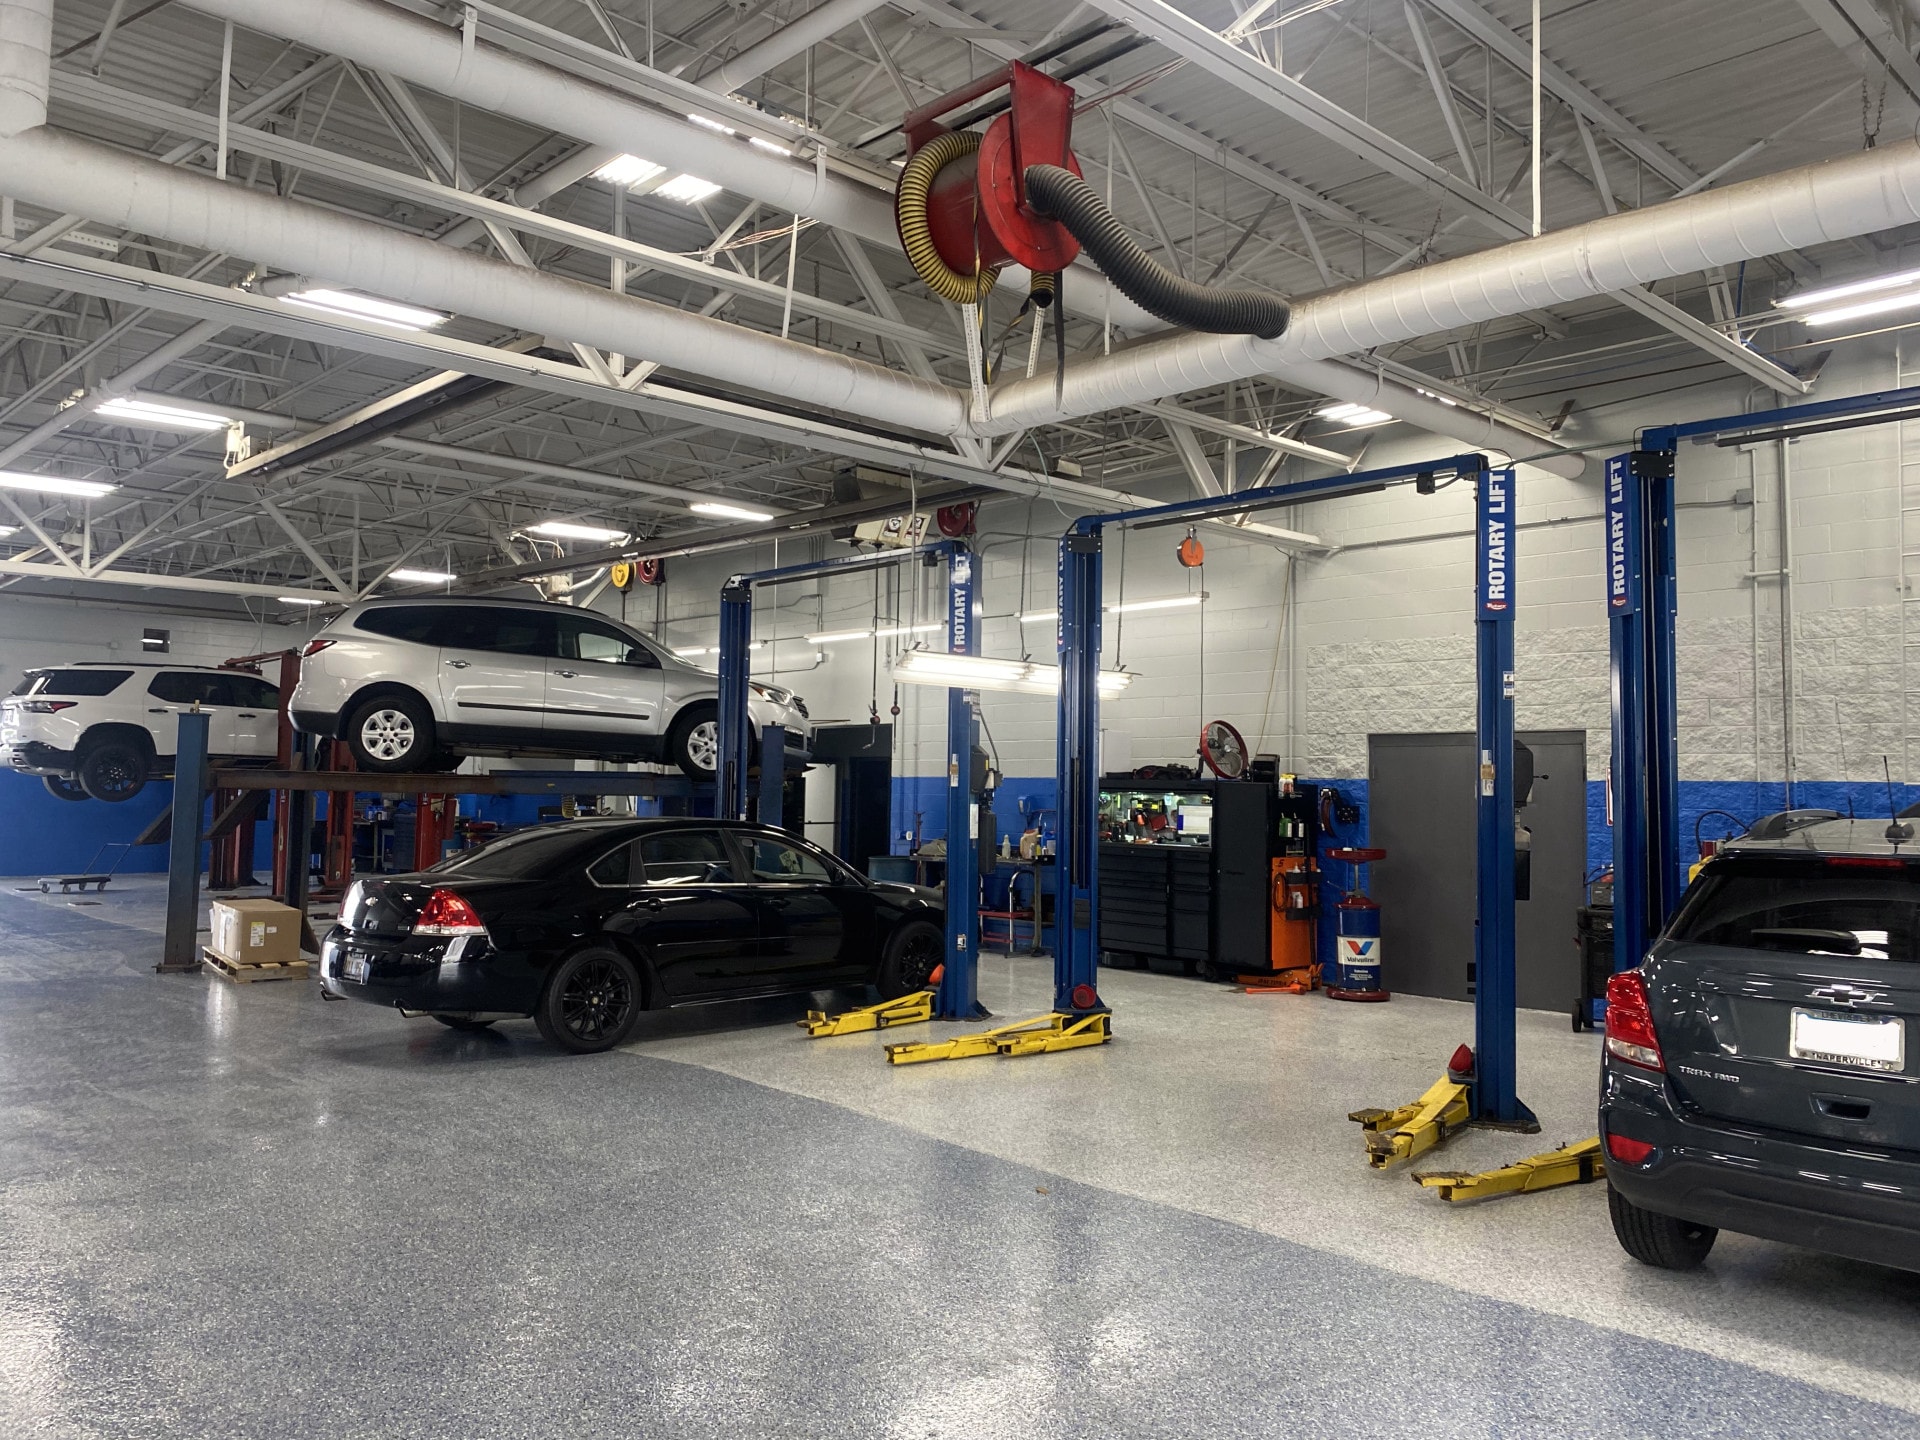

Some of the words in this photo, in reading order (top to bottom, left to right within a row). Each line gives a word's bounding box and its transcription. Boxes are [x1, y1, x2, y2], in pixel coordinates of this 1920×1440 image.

[1489, 472, 1506, 513] LIFT
[1610, 461, 1623, 504] LIFT
[1488, 520, 1506, 599] ROTARY
[1611, 511, 1625, 595] ROTARY
[954, 588, 966, 645] ROTARY
[1678, 1065, 1712, 1078] TRAX
